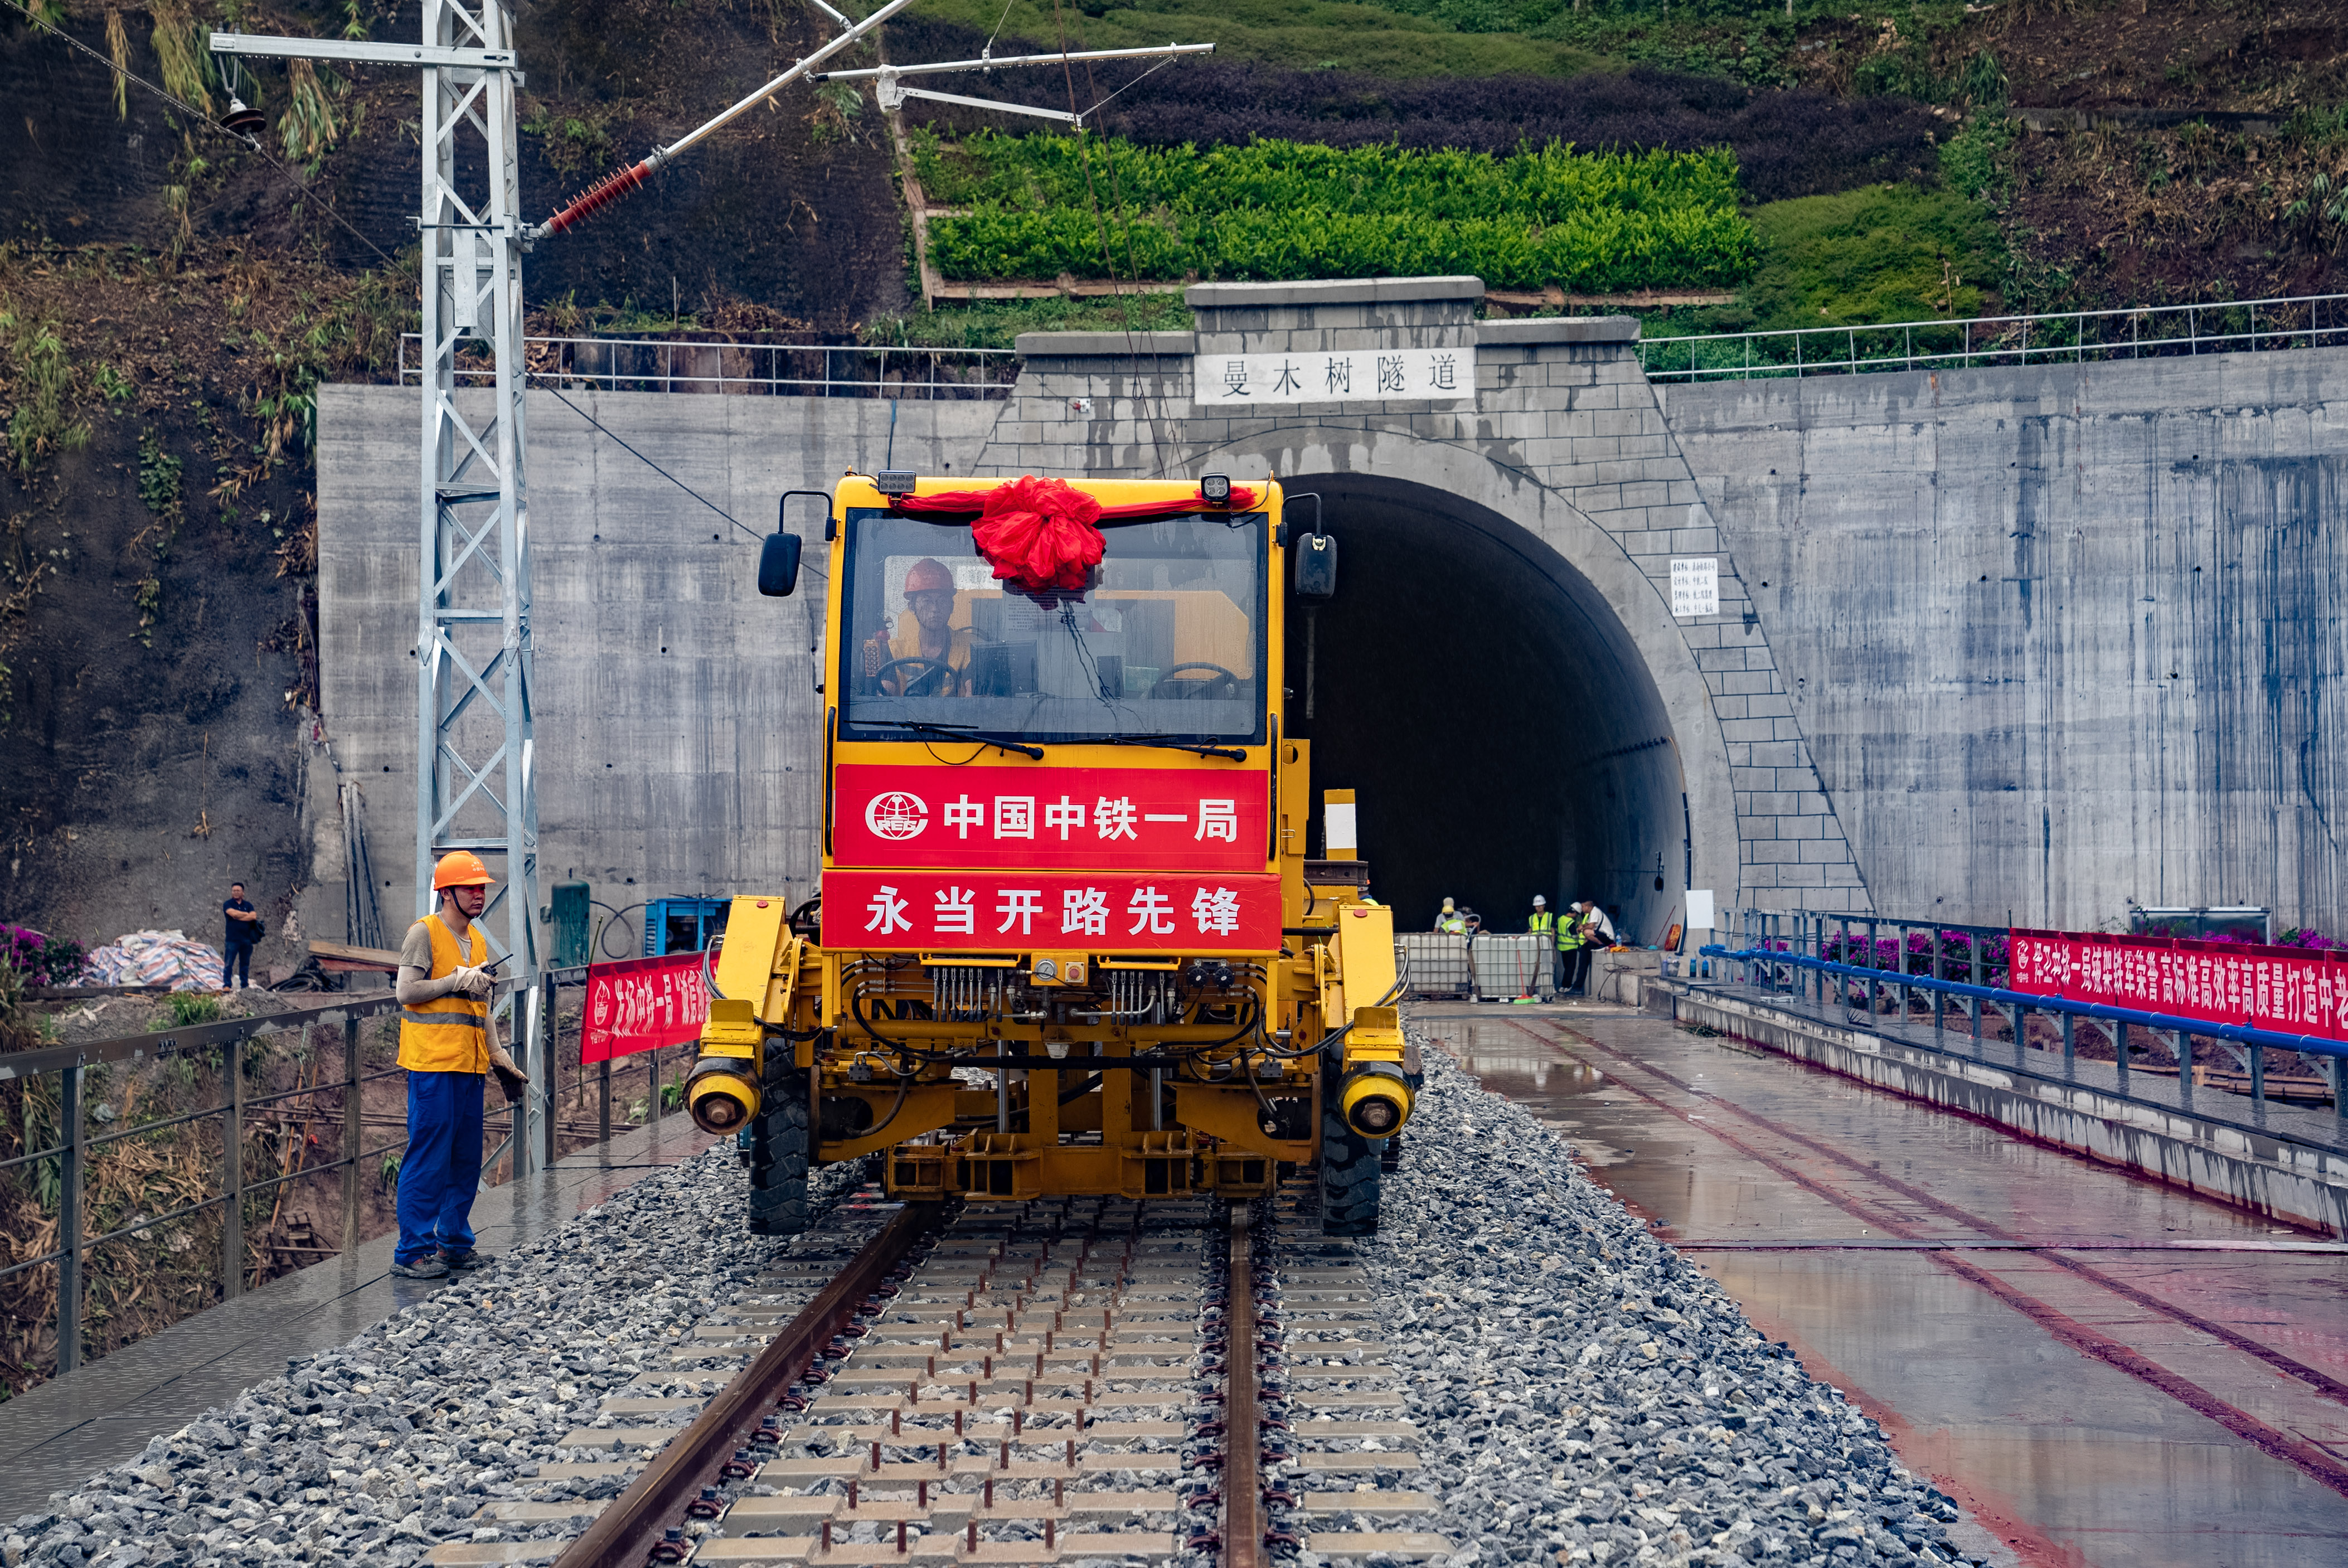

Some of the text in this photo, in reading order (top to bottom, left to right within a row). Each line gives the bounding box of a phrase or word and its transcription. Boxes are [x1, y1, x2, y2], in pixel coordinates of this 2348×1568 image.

[1222, 353, 1457, 397] 曼木树隧道
[944, 794, 1237, 842] 中国中铁一局
[864, 886, 1240, 936] 永当开路先锋
